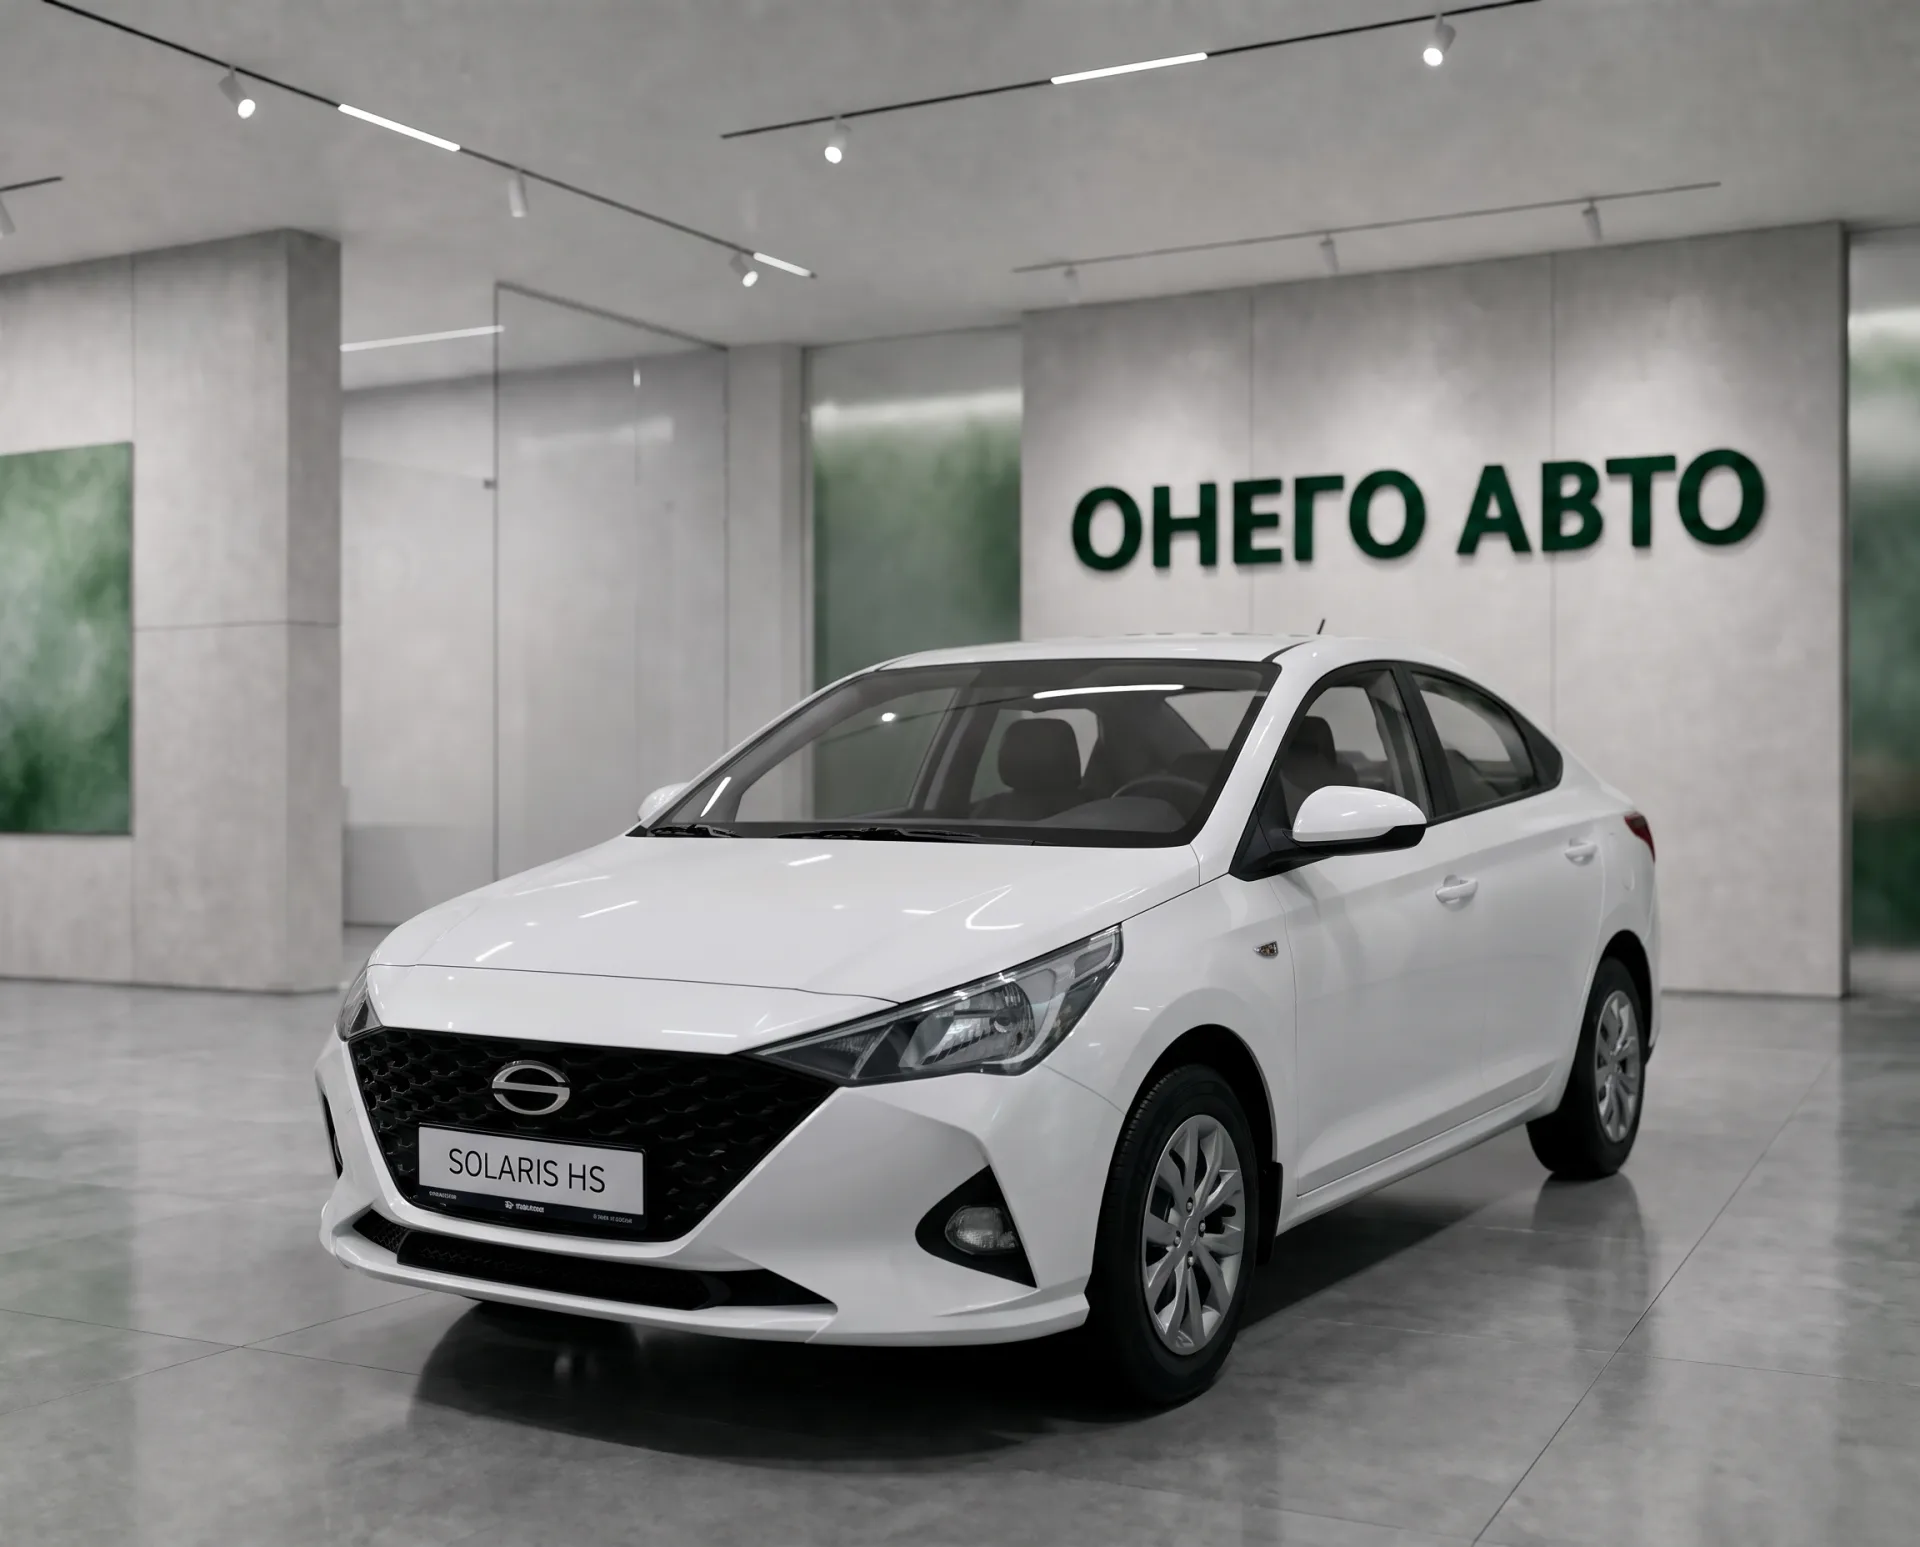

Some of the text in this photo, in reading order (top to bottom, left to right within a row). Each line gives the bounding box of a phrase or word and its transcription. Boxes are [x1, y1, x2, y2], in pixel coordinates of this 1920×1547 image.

[1072, 448, 1766, 571] ОНЕГО АВТО
[449, 1148, 606, 1193] SOLARIS HS
